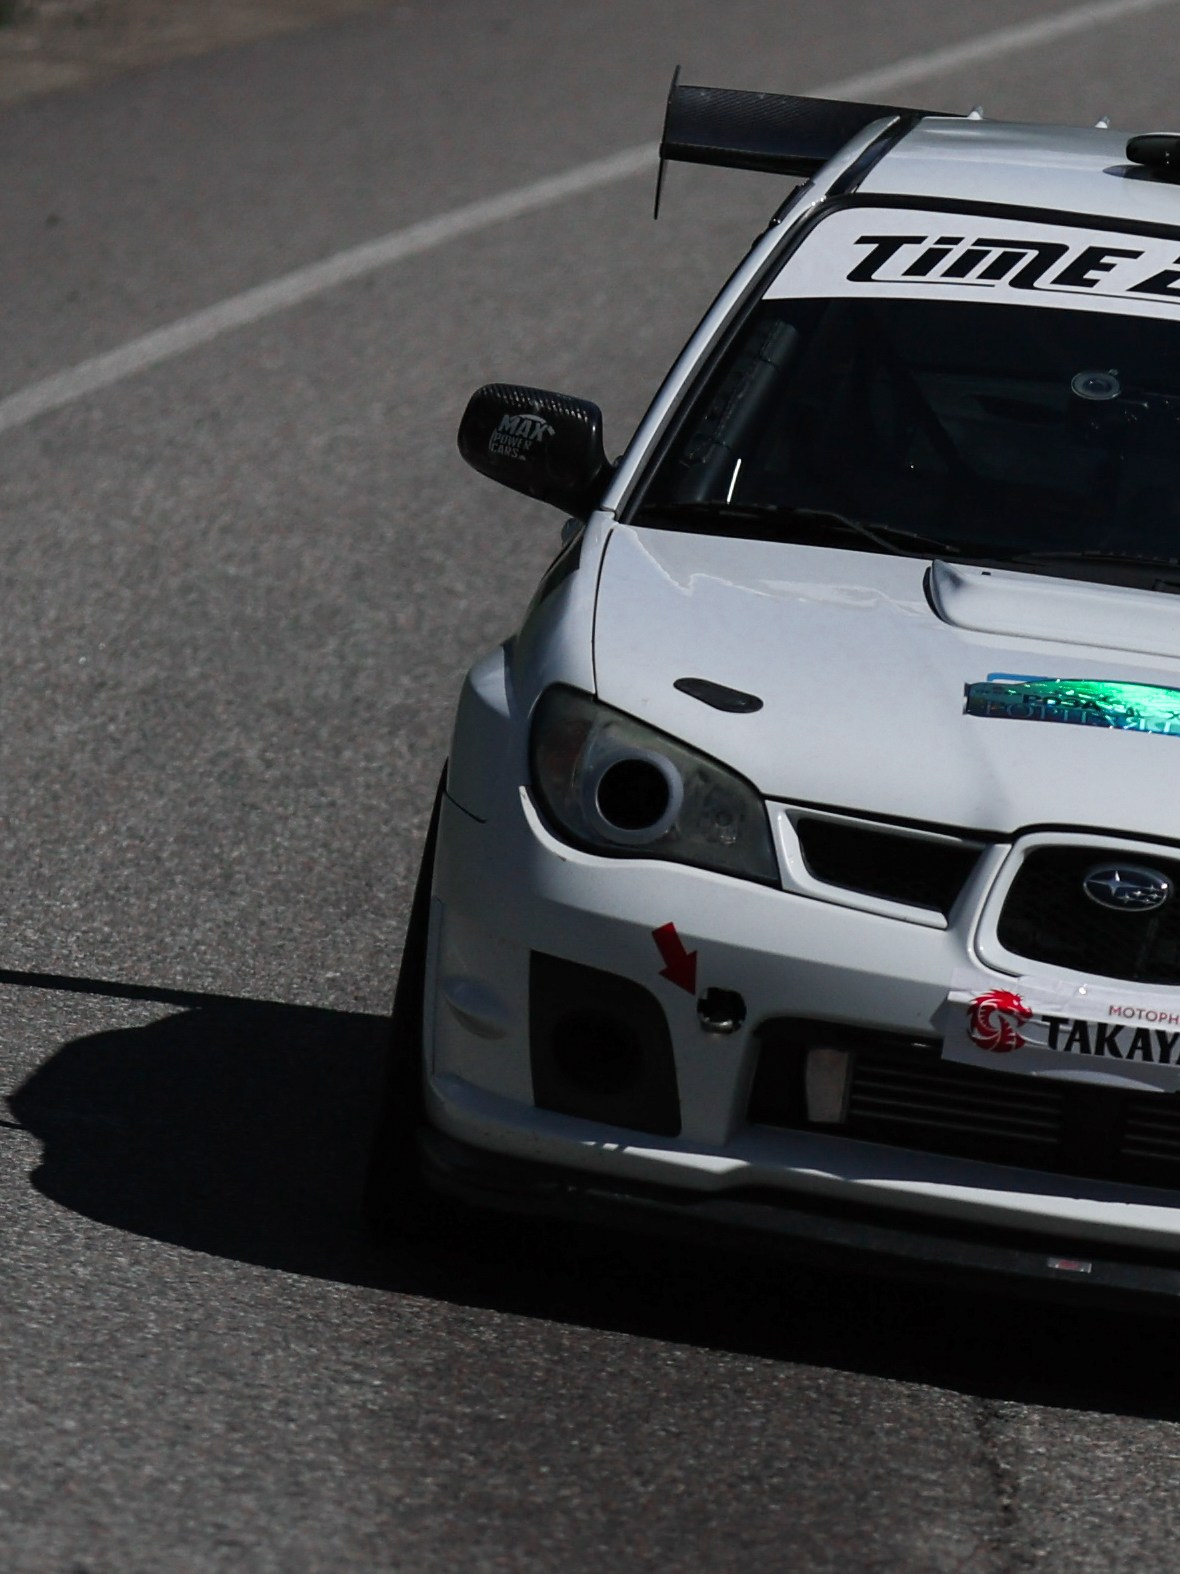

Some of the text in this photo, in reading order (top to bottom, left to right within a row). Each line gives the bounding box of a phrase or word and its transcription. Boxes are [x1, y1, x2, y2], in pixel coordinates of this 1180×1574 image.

[498, 414, 548, 442] MAX
[491, 443, 519, 457] CARS
[494, 432, 533, 450] POWER
